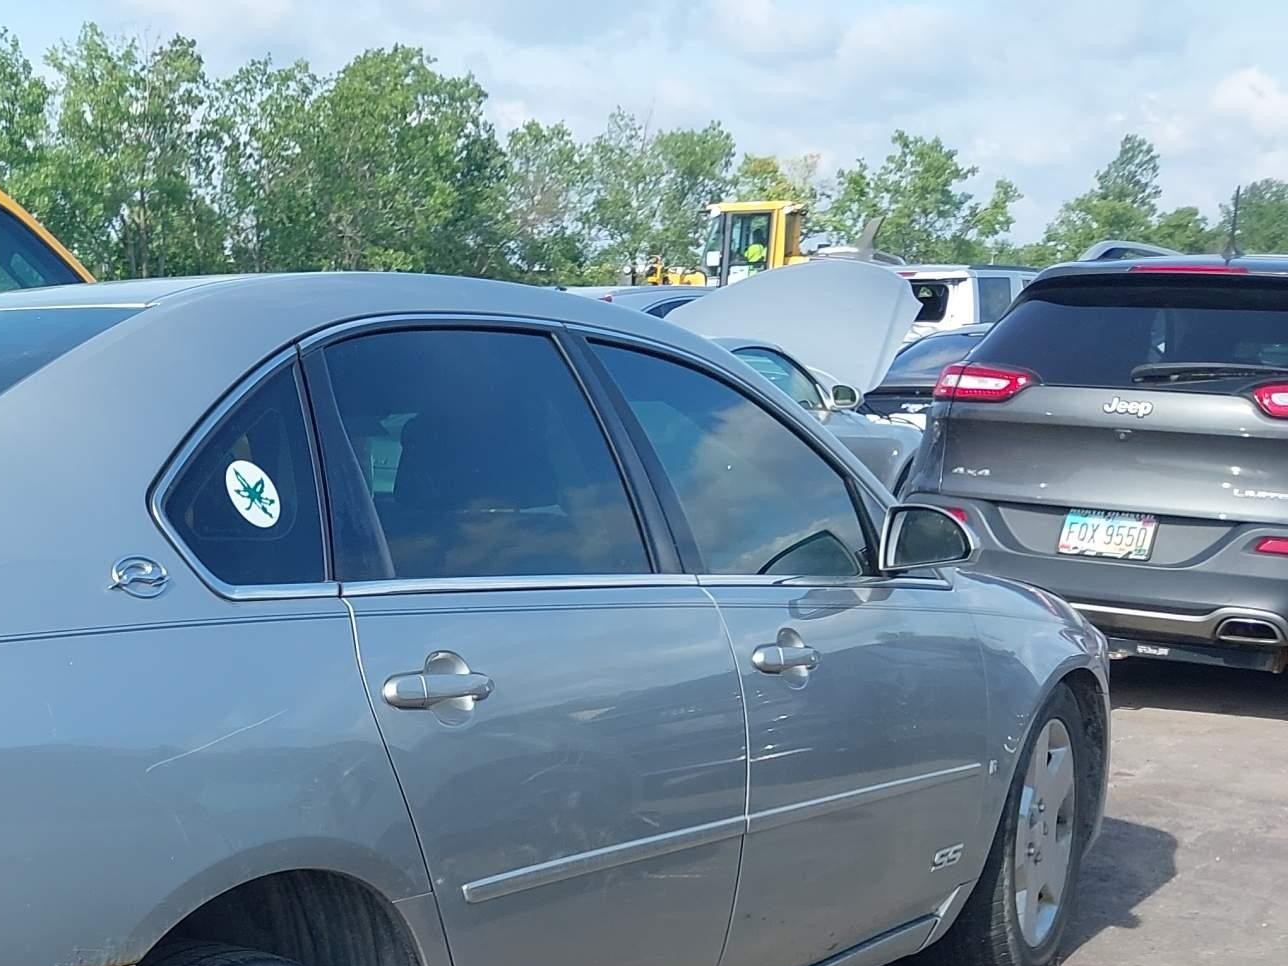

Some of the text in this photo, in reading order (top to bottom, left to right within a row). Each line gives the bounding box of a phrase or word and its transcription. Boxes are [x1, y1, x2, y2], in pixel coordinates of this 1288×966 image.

[1103, 396, 1153, 418] Jeep
[1065, 521, 1148, 549] FOX 9550
[931, 843, 964, 872] SS
